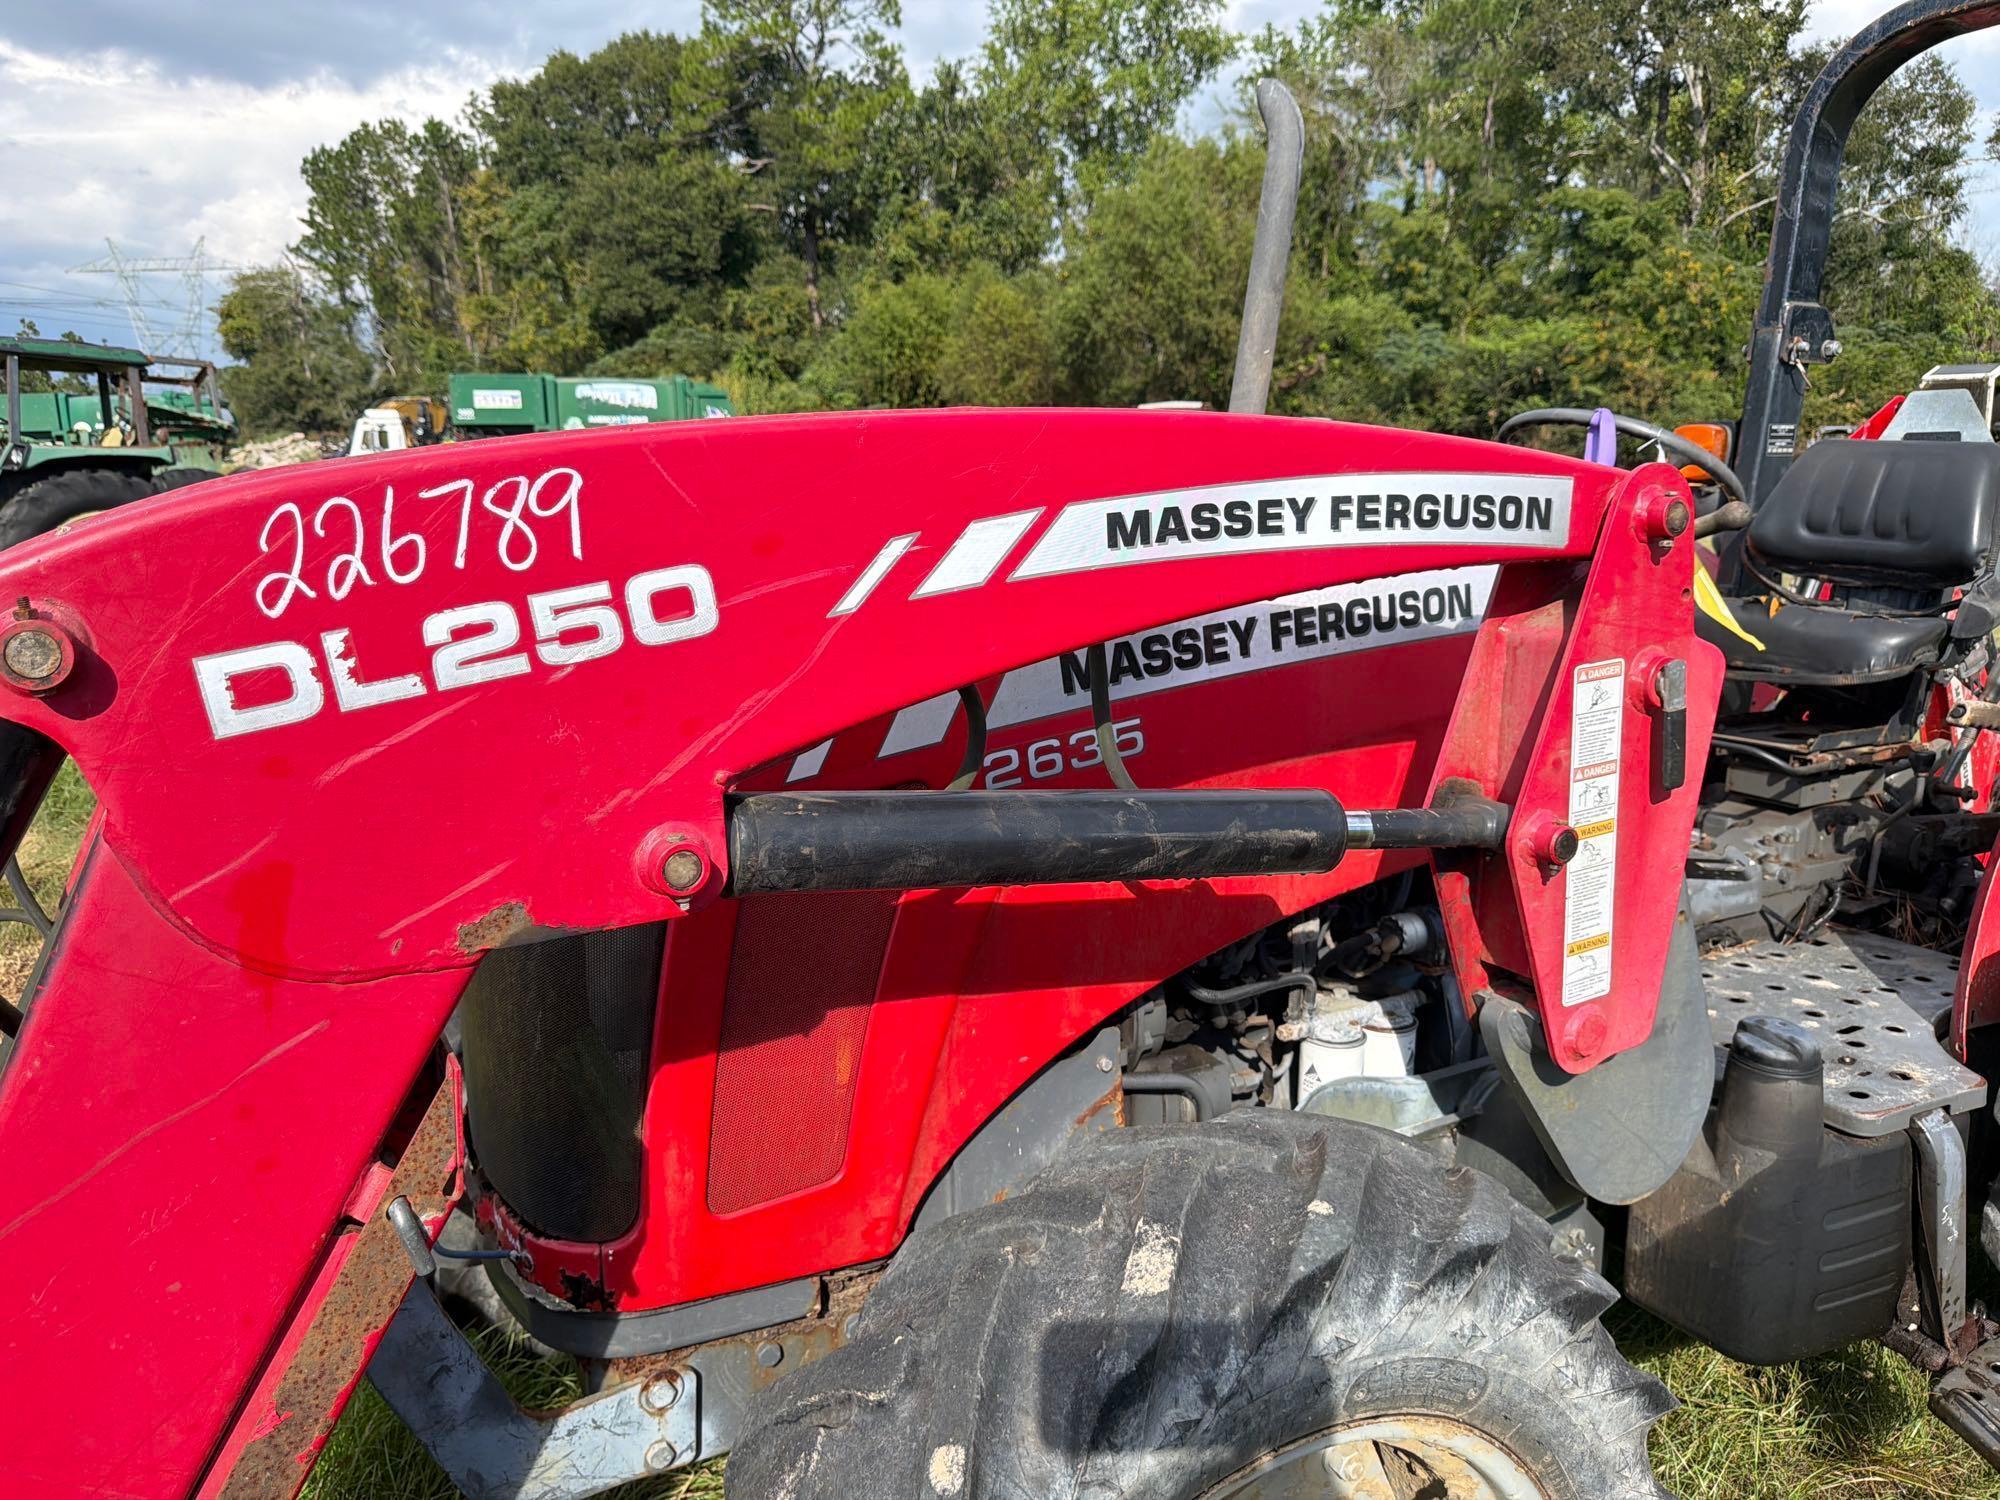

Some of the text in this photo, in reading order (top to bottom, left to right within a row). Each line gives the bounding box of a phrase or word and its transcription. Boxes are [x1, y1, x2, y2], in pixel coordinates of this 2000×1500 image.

[255, 467, 584, 619] 226789
[1106, 493, 1553, 551] MASSEY FERGUSON
[192, 563, 720, 740] DL250
[1060, 583, 1473, 696] MASSEY FERGUSON
[1588, 664, 1621, 679] DANGER
[983, 717, 1145, 790] 2635
[1583, 762, 1617, 777] DANGER
[1580, 821, 1613, 838] WARNING
[1575, 936, 1609, 951] WARNING
